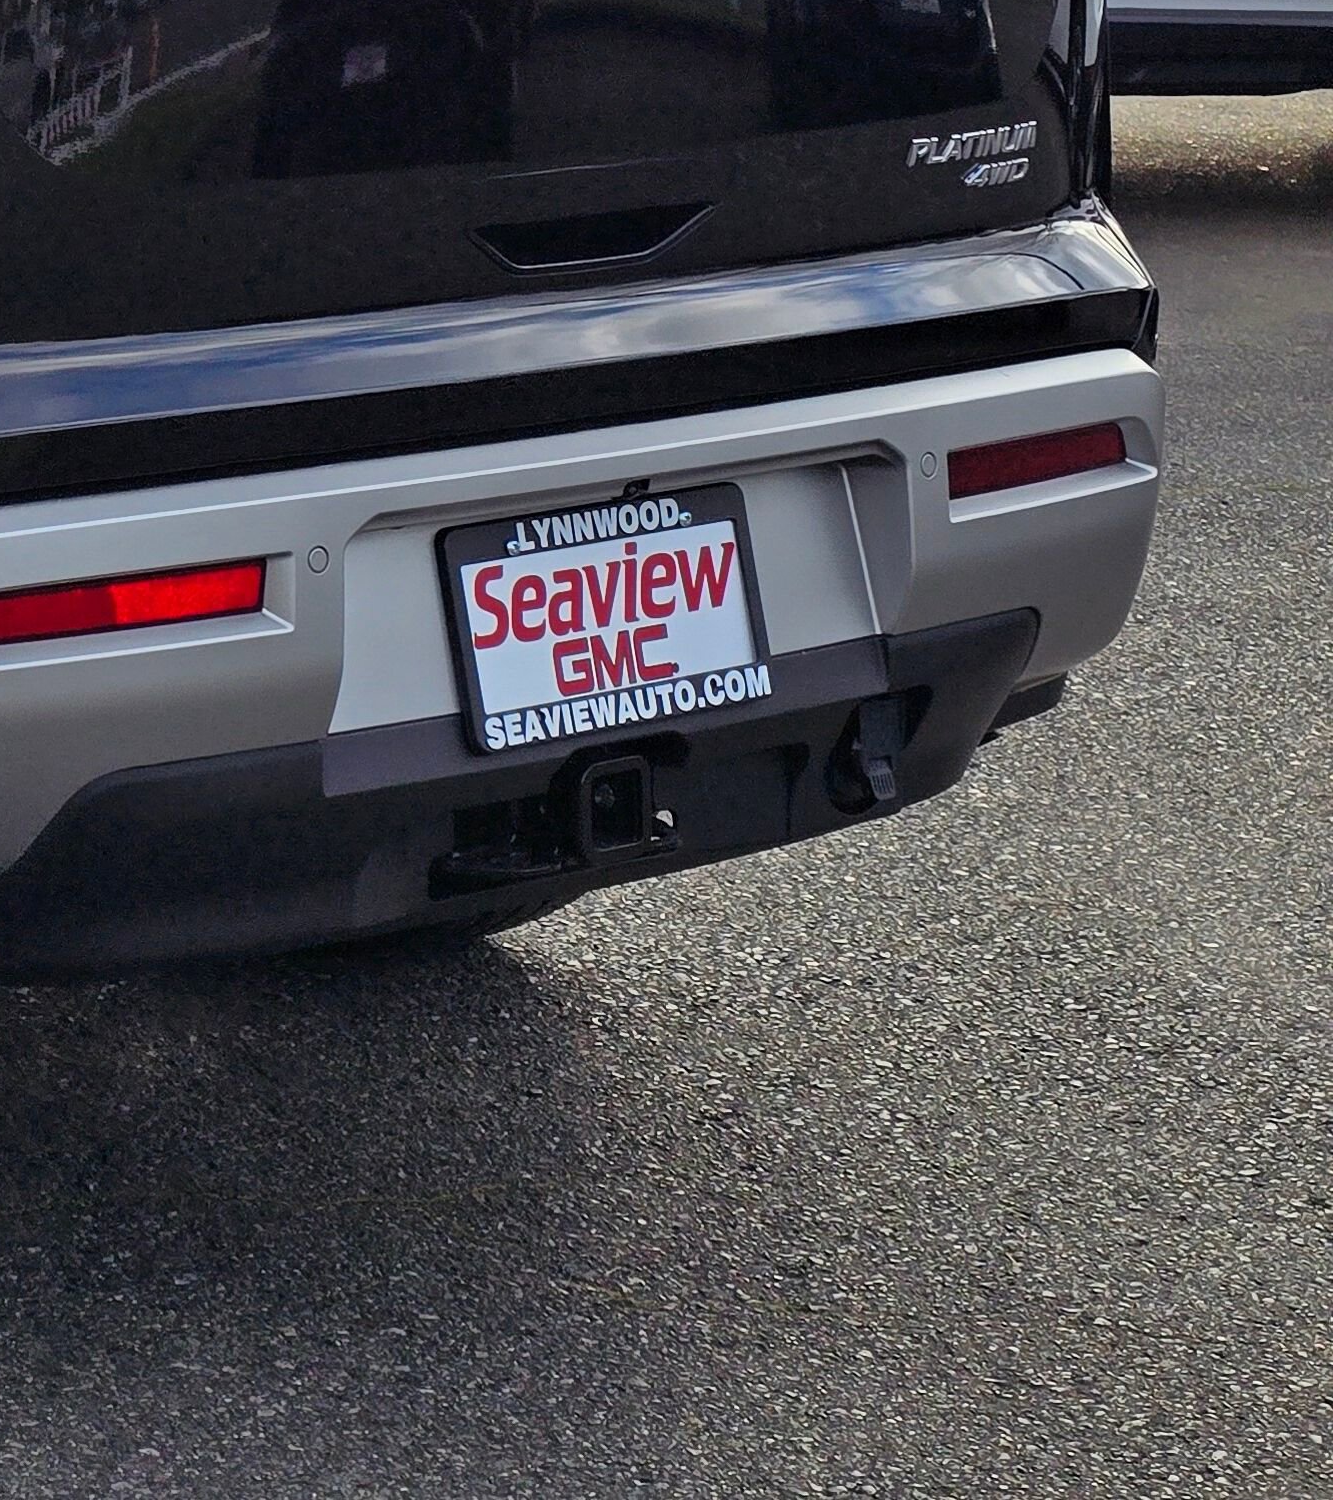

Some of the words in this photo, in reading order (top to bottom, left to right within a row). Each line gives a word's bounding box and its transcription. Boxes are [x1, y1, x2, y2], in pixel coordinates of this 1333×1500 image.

[906, 120, 1038, 168] PLATINUM
[961, 157, 1030, 188] 4WD
[515, 498, 680, 552] LYNNWOOD
[474, 541, 735, 650] Seaview
[552, 623, 679, 698] GMC
[485, 665, 772, 751] SEAVIEWAUTO.COM
